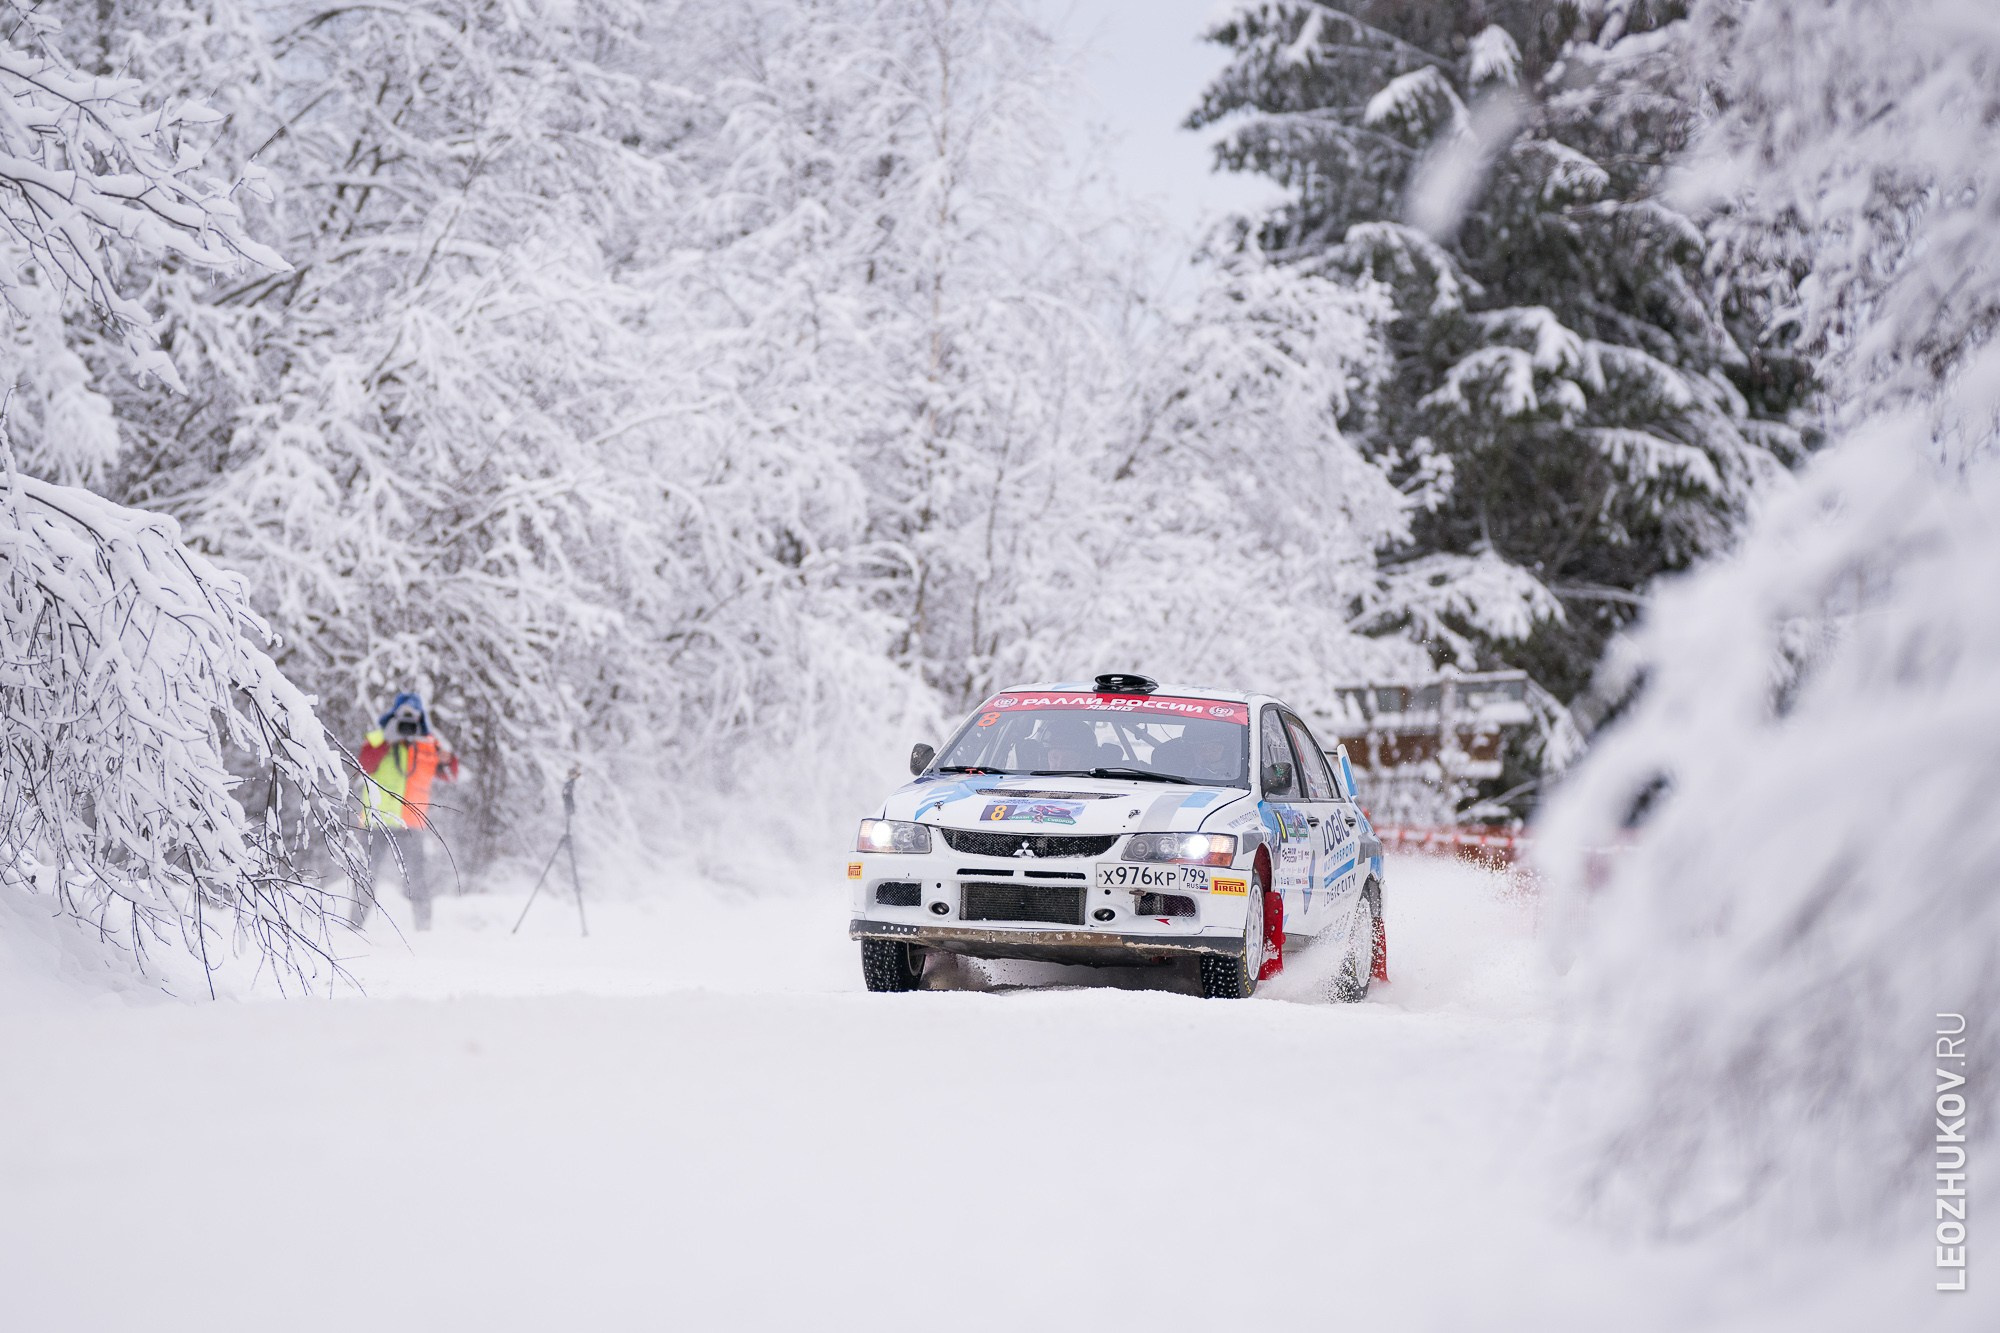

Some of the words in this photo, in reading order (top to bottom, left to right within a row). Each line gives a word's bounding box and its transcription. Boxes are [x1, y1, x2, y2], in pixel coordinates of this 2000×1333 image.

[1021, 697, 1104, 706] РАЛЛИ
[1109, 698, 1204, 713] РОССИИ
[976, 711, 1001, 728] 8
[990, 804, 1007, 821] 8
[1321, 808, 1350, 856] LOGIC
[1323, 841, 1355, 872] MOTORSPORT
[1103, 866, 1176, 886] Х976КР
[1181, 867, 1206, 883] 799
[1186, 882, 1199, 890] RUS
[1214, 880, 1245, 893] PIRELLI
[1323, 883, 1340, 907] LOGIC
[1341, 873, 1357, 890] CITY
